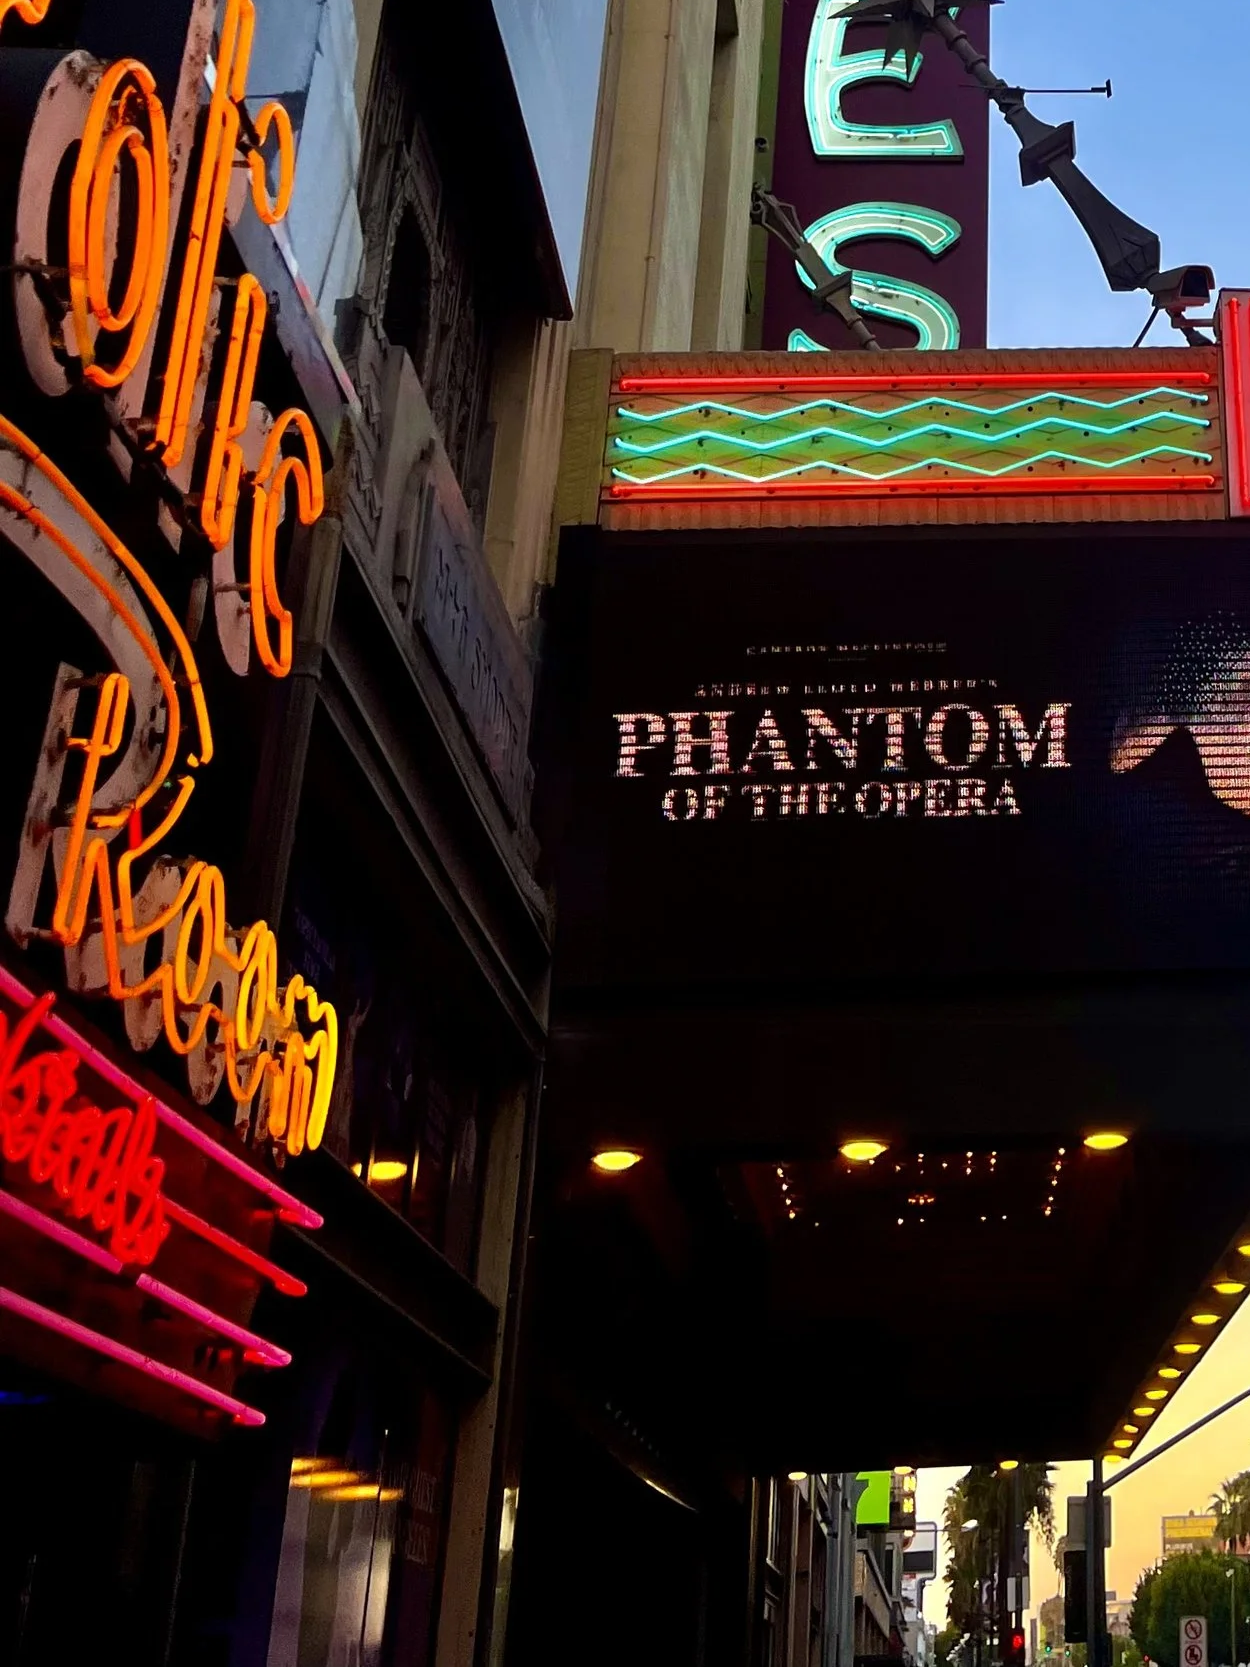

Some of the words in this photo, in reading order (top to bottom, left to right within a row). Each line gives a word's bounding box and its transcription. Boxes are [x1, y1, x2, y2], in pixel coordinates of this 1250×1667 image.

[611, 702, 1073, 778] PHANTOM
[661, 784, 731, 822] OF
[740, 781, 847, 821] THE
[854, 777, 1023, 820] OPERA
